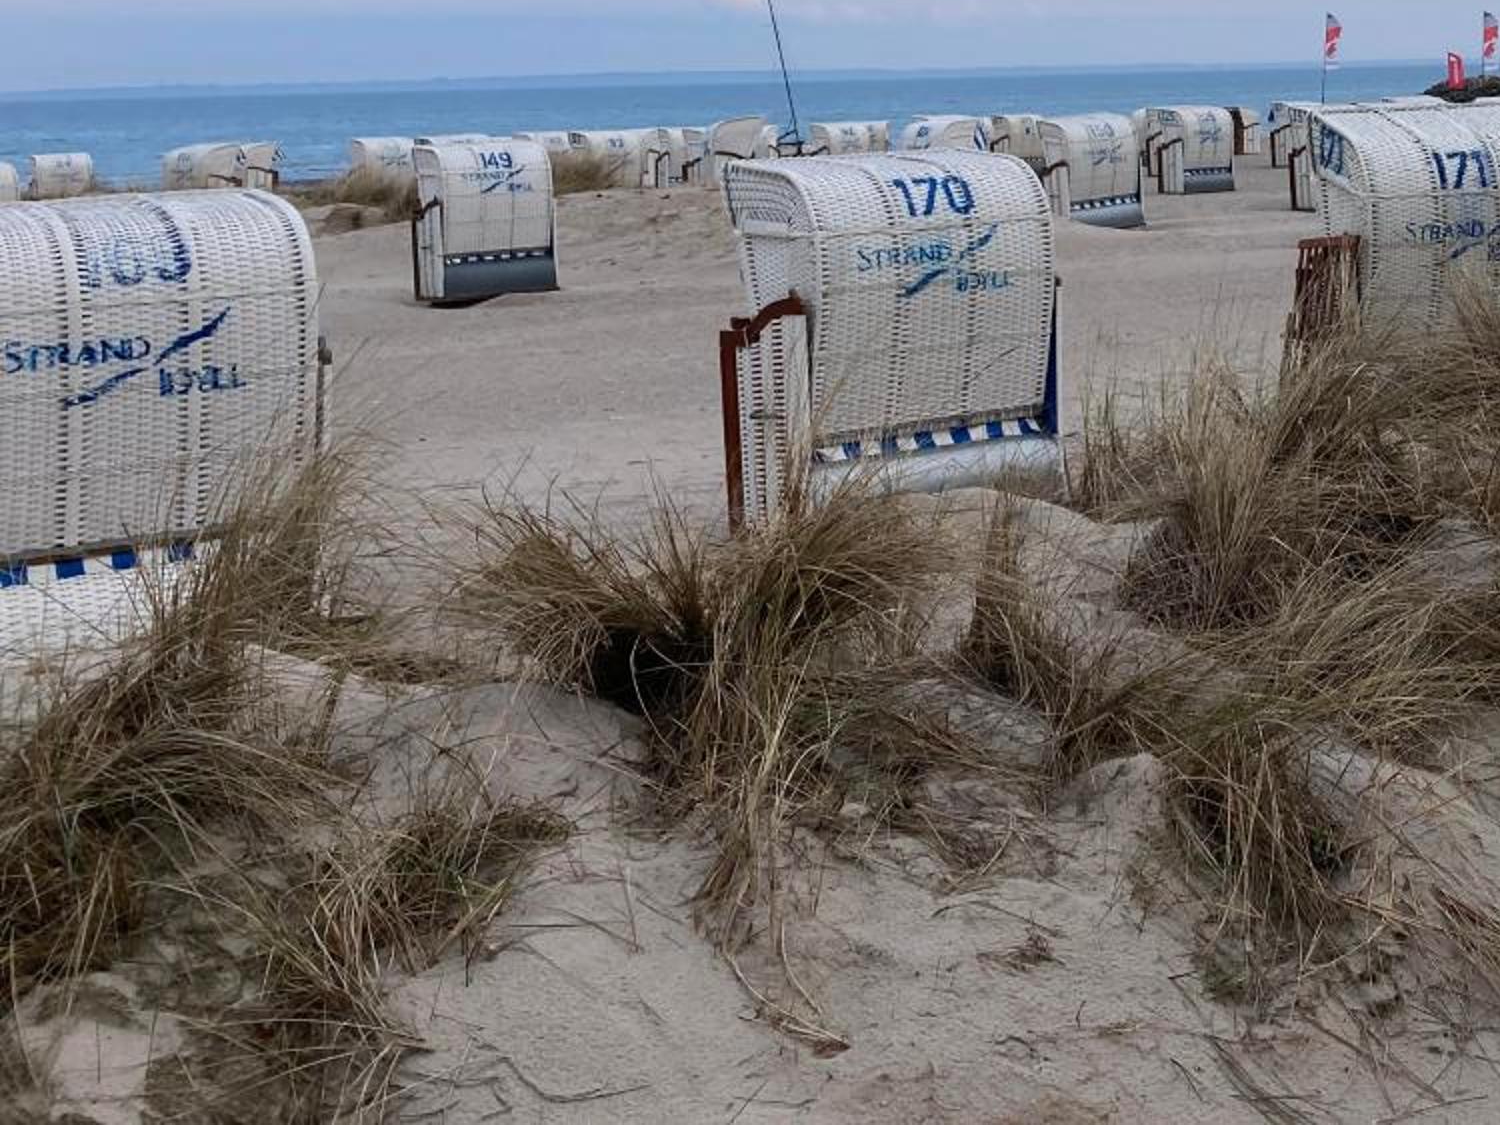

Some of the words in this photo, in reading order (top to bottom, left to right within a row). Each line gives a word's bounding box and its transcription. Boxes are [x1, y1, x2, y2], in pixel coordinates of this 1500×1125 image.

[479, 151, 513, 169] 149
[1432, 150, 1489, 190] 171
[892, 176, 976, 218] 170
[857, 242, 953, 272] STRAND
[2, 336, 151, 374] STRAND
